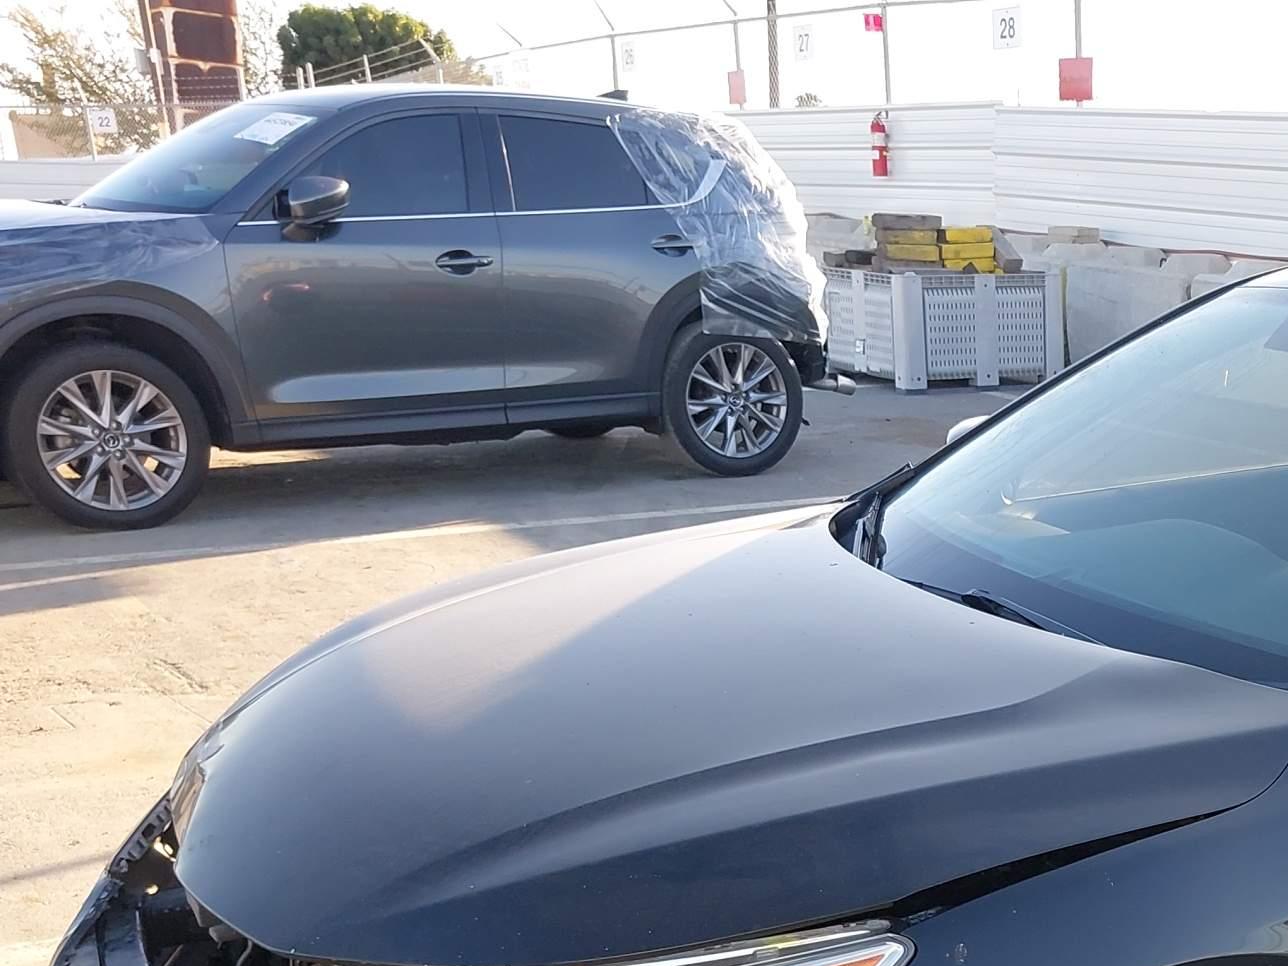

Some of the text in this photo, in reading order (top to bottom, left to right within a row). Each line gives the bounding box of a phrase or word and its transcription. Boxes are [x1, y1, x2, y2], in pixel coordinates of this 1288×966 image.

[1000, 17, 1016, 39] 28
[799, 33, 810, 52] 27
[98, 116, 112, 127] 22
